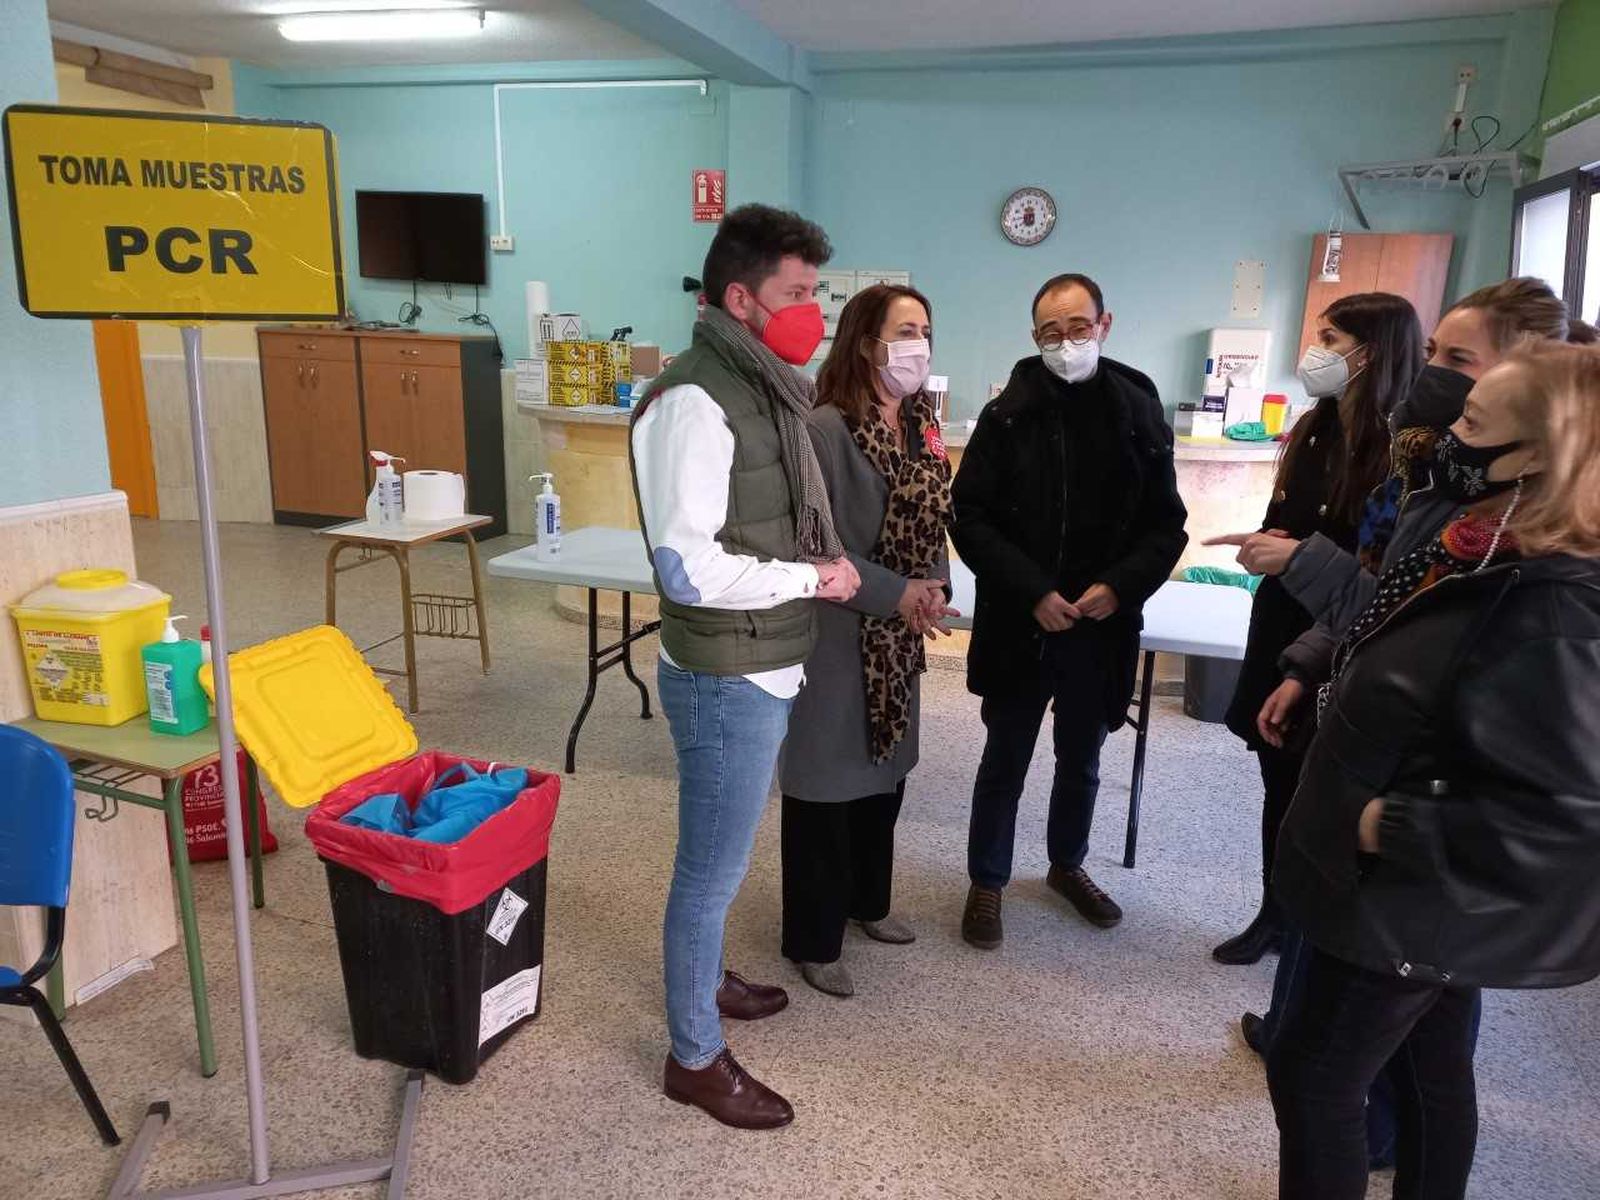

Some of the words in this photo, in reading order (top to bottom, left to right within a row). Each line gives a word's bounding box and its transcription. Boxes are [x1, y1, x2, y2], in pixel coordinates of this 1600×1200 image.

[38, 155, 132, 187] TOMA
[140, 160, 306, 194] MUESTRAS
[104, 225, 258, 275] PCR
